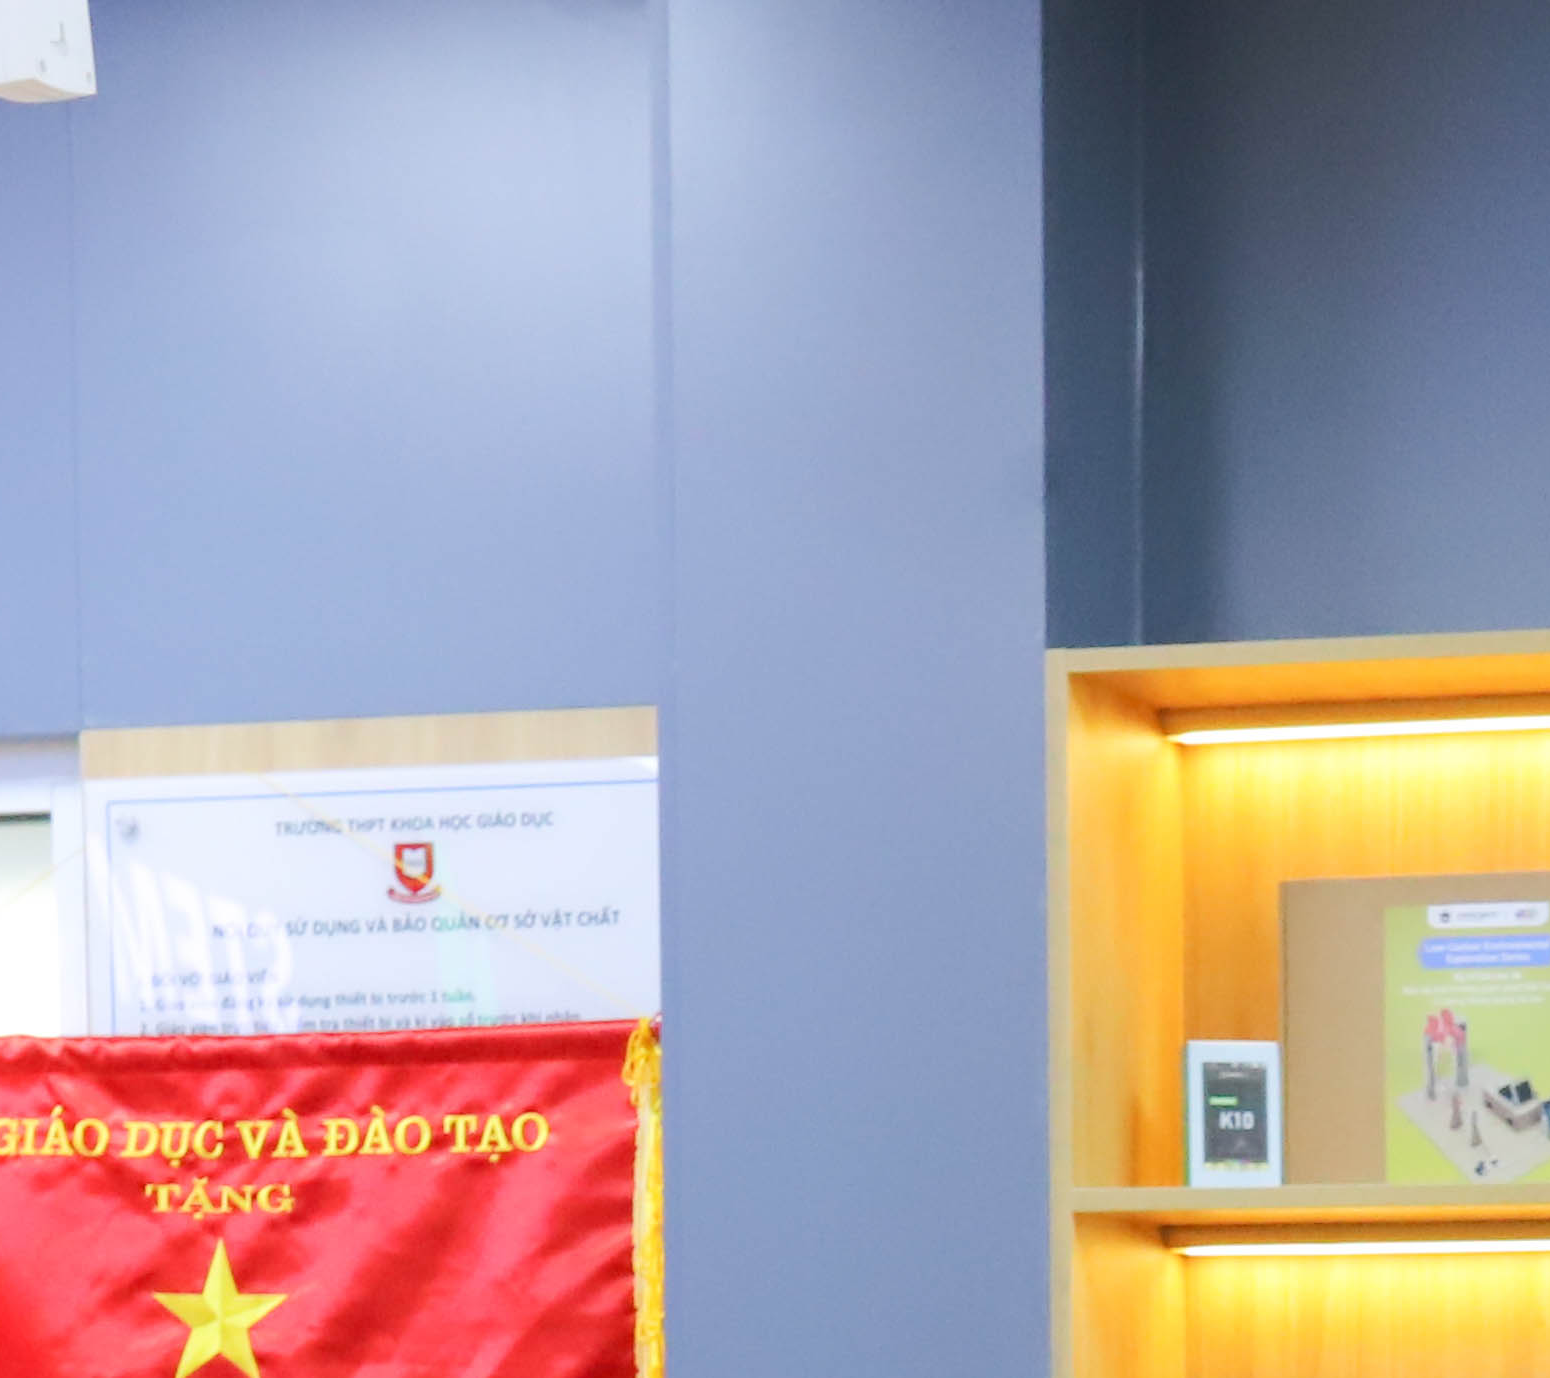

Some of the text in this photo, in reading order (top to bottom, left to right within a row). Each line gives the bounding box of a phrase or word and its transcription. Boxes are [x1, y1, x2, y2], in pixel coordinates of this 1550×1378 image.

[348, 818, 385, 834] THPT
[390, 816, 434, 832] KHOA
[439, 814, 472, 833] HỌC
[476, 811, 517, 829] GIÁO
[312, 917, 361, 937] DỤNG
[365, 914, 388, 933] VÀ
[1218, 1110, 1255, 1131] K10
[119, 1119, 225, 1167] DỤC
[236, 1108, 307, 1160] VÀ
[321, 1105, 431, 1156] ĐÀO
[443, 1112, 550, 1163] TẠO
[145, 1177, 295, 1220] TẶNG
